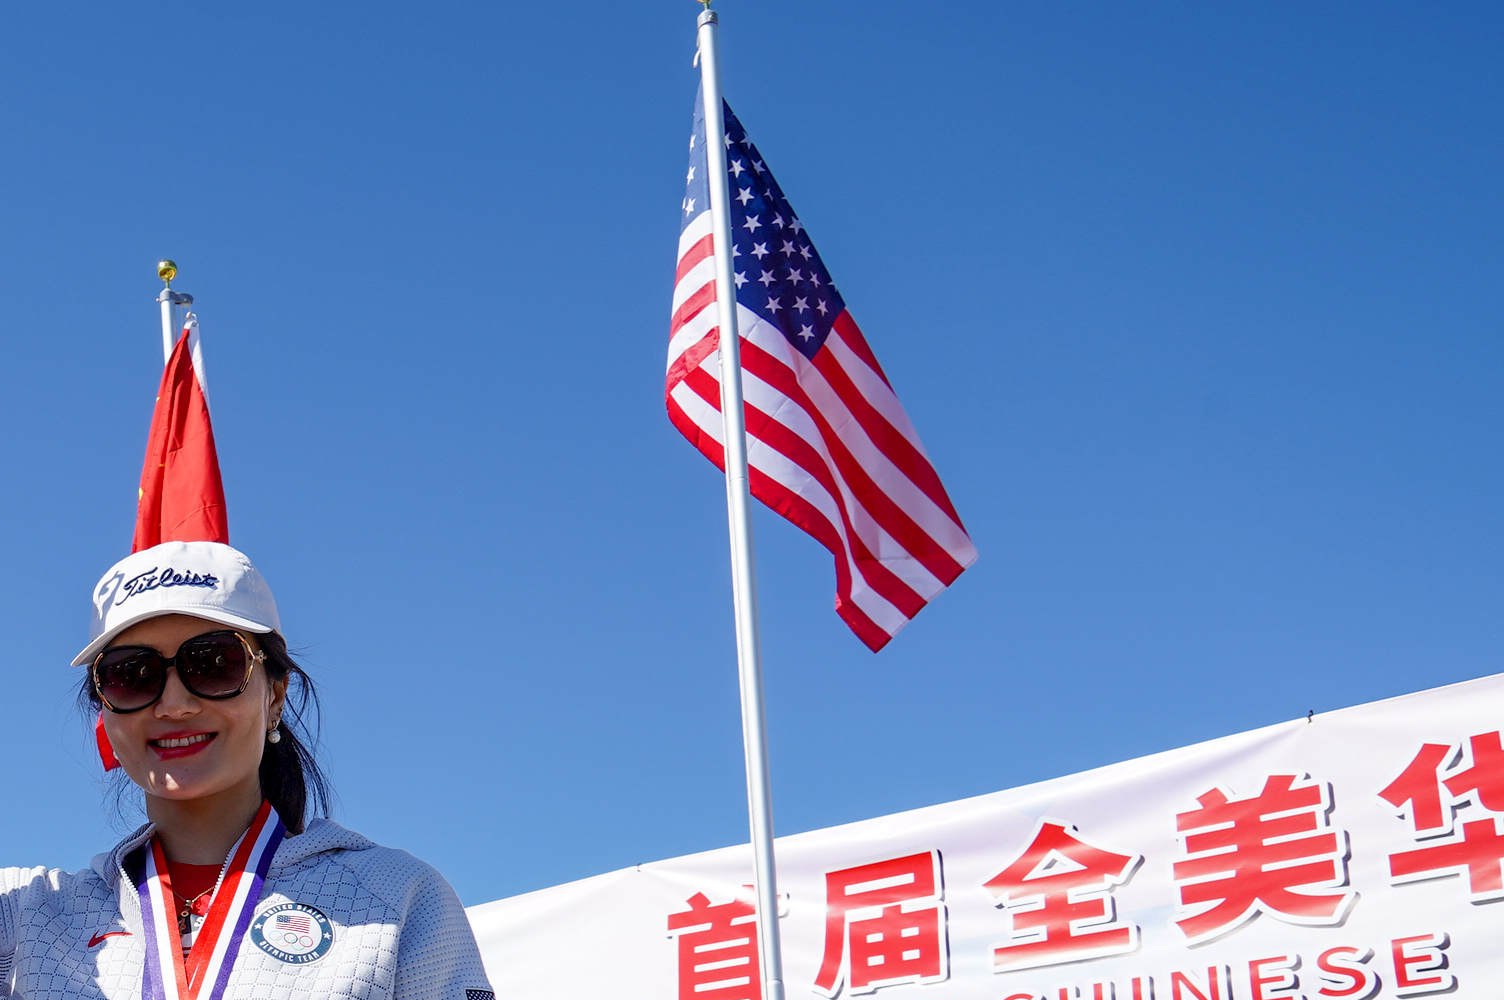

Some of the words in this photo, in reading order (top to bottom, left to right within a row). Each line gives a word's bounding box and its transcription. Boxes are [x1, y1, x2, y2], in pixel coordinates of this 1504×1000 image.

[115, 566, 219, 606] Titleist
[262, 903, 293, 918] UNITED
[296, 903, 327, 924] STATES
[258, 939, 294, 962] OLYMPIC
[297, 950, 320, 963] TEAM
